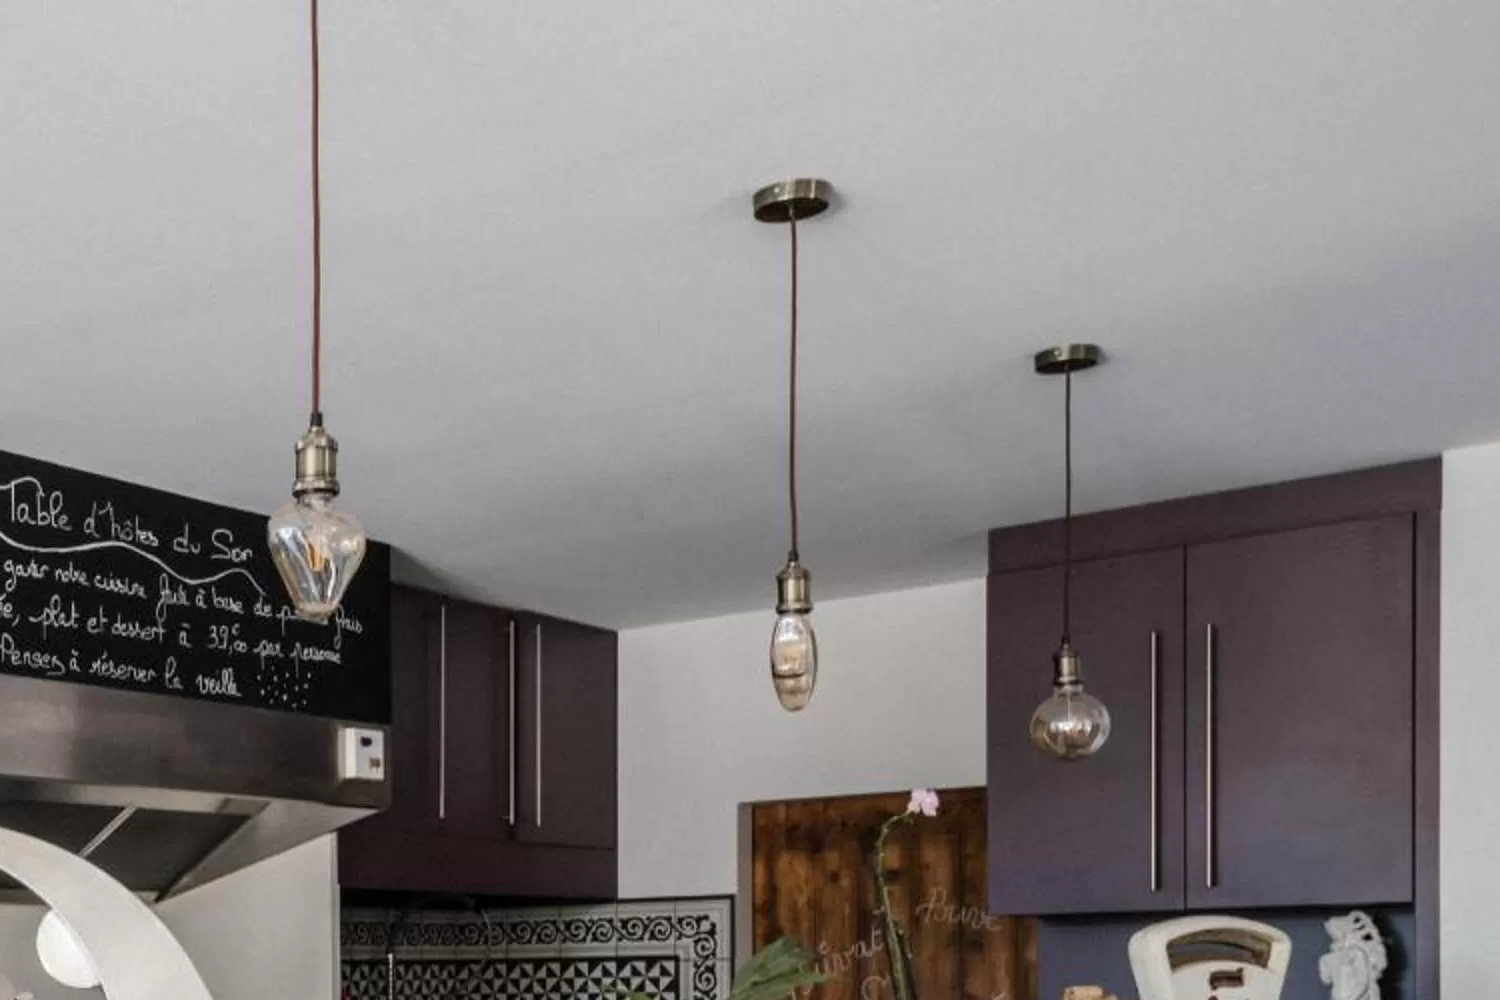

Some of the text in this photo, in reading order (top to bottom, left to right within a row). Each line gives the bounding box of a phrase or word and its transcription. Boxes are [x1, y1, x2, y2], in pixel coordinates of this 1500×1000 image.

[83, 501, 159, 548] d'hôtes
[173, 522, 201, 552] du
[55, 561, 90, 586] notre
[212, 585, 244, 614] base
[254, 596, 273, 617] de
[28, 594, 80, 640] plat
[87, 605, 108, 633] et
[112, 613, 165, 644] dessert
[252, 639, 284, 670] par
[165, 656, 184, 689] la
[196, 667, 243, 697] veille
